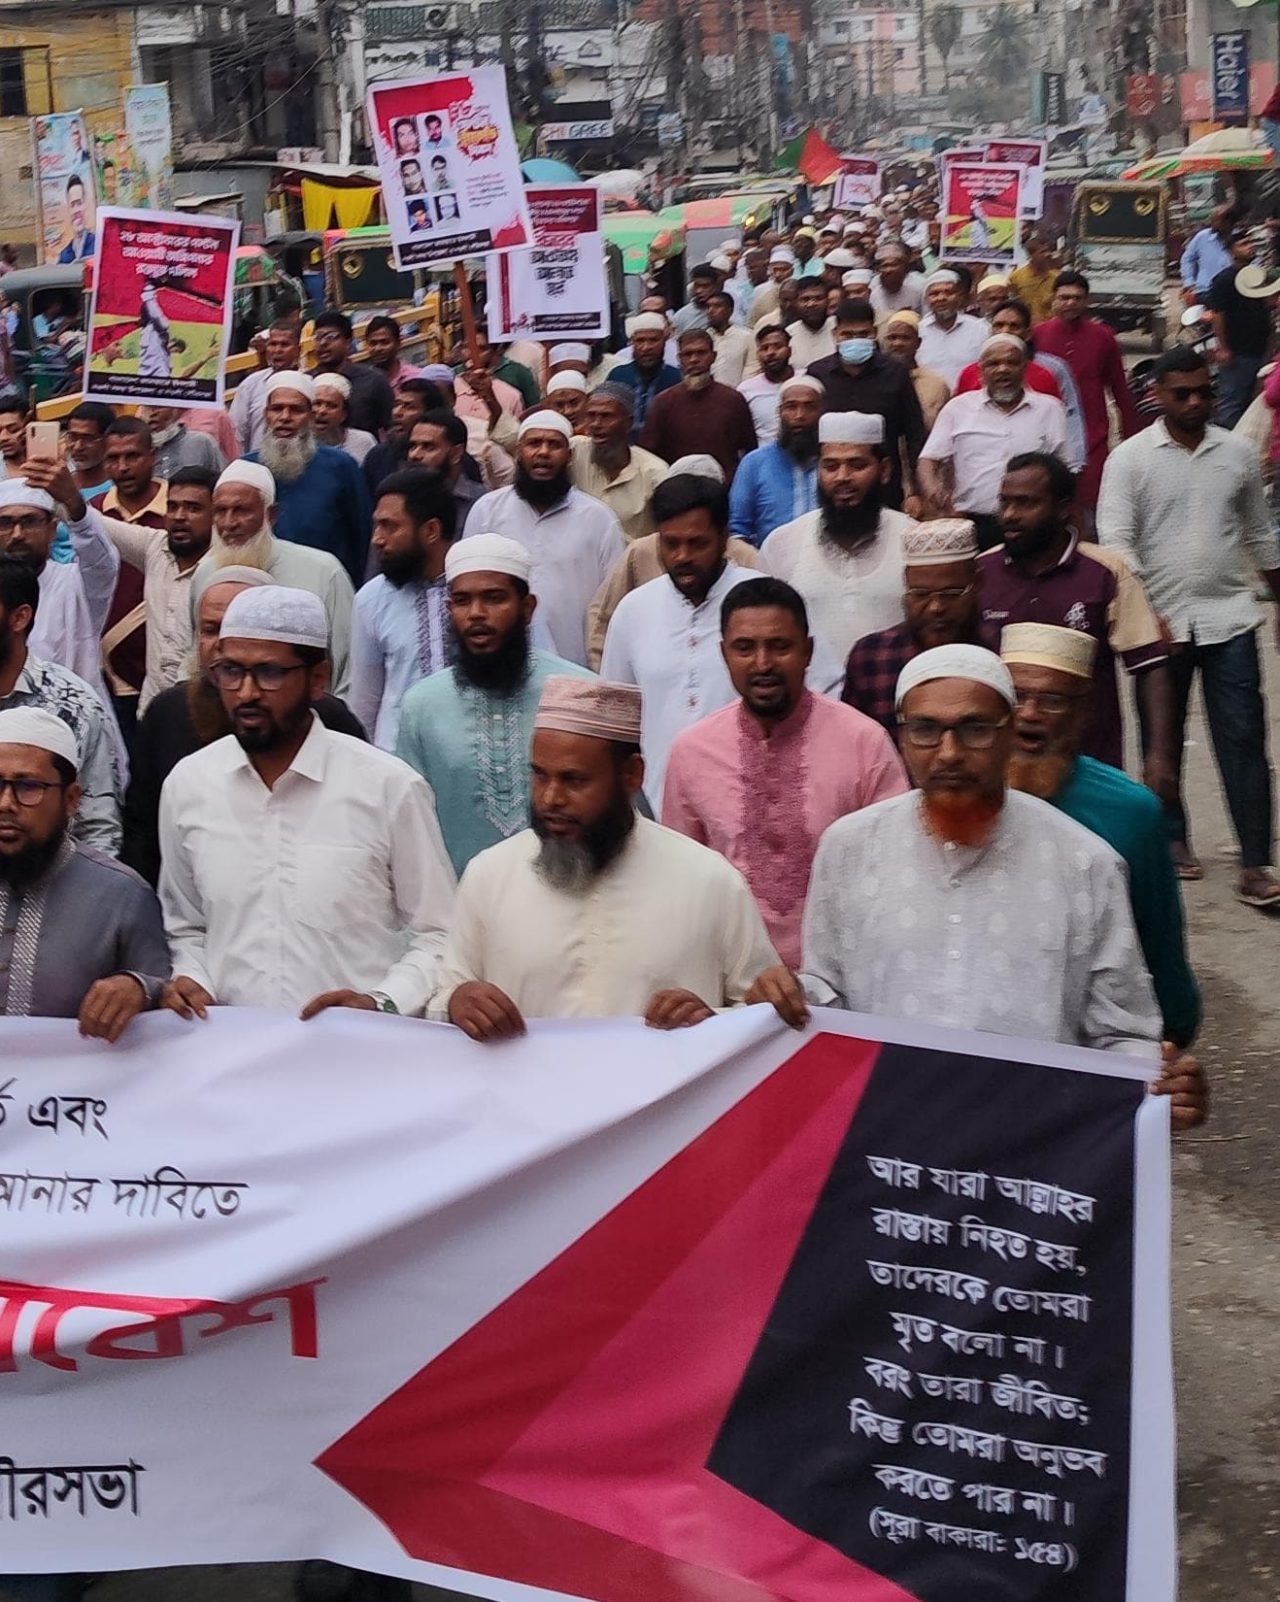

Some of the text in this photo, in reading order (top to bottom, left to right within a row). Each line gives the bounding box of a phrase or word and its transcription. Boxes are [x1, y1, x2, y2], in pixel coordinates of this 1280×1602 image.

[1216, 33, 1246, 99] Haier
[27, 1095, 110, 1141] এবং
[111, 1165, 250, 1222] দাবিতে
[865, 1154, 1099, 1224] আর যারা আল্লাহর
[870, 1207, 1089, 1277] রাস্তায় নিহত হয়,
[864, 1259, 1094, 1323] তাদেরকে তোমরা
[887, 1310, 939, 1353] মৃত
[939, 1322, 1007, 1358] বলো
[1011, 1334, 1049, 1366] না
[862, 1355, 915, 1400] বরং
[916, 1371, 985, 1405] তারা
[847, 1397, 1110, 1480] কিন্তু তোমরা অনুভব
[870, 1462, 957, 1502] করতে
[960, 1481, 1019, 1516] পার
[1018, 1489, 1059, 1523] না
[868, 1505, 921, 1545] (সূরা
[1013, 1536, 1080, 1574] ১৫৪)
